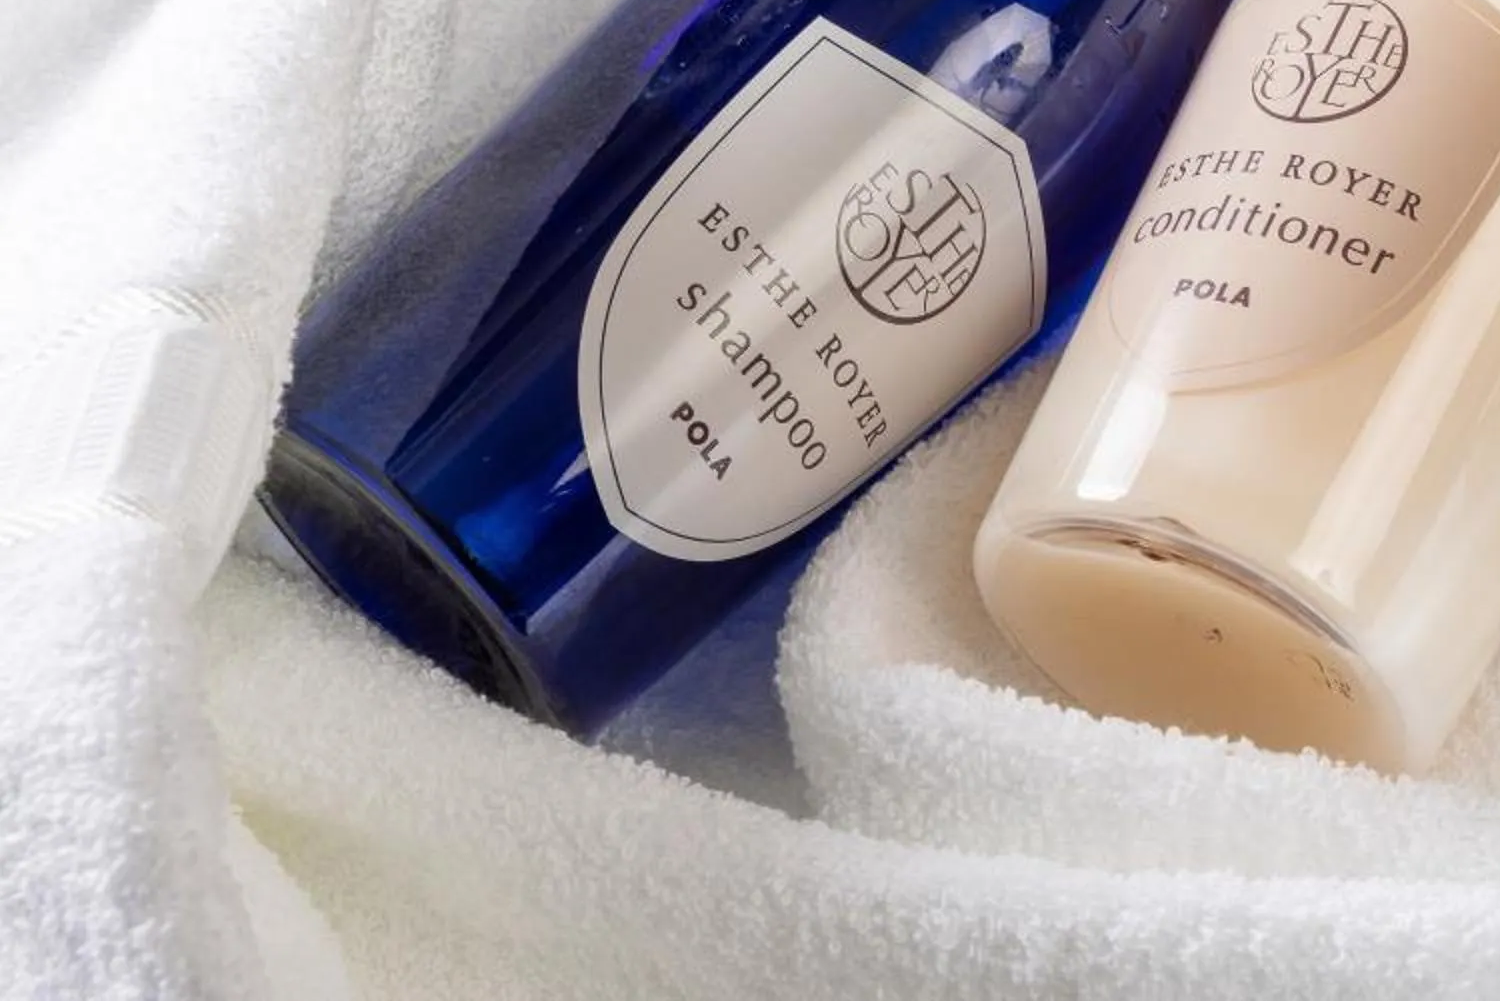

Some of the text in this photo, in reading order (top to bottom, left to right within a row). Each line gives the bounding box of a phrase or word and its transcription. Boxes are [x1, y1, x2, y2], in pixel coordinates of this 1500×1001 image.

[1156, 149, 1425, 224] ESTHE ROYER
[1133, 194, 1396, 276] conditioner
[698, 203, 888, 449] ESTHE ROYER
[1173, 278, 1251, 308] POLA
[676, 282, 828, 471] shampoo
[669, 401, 733, 481] POLA
